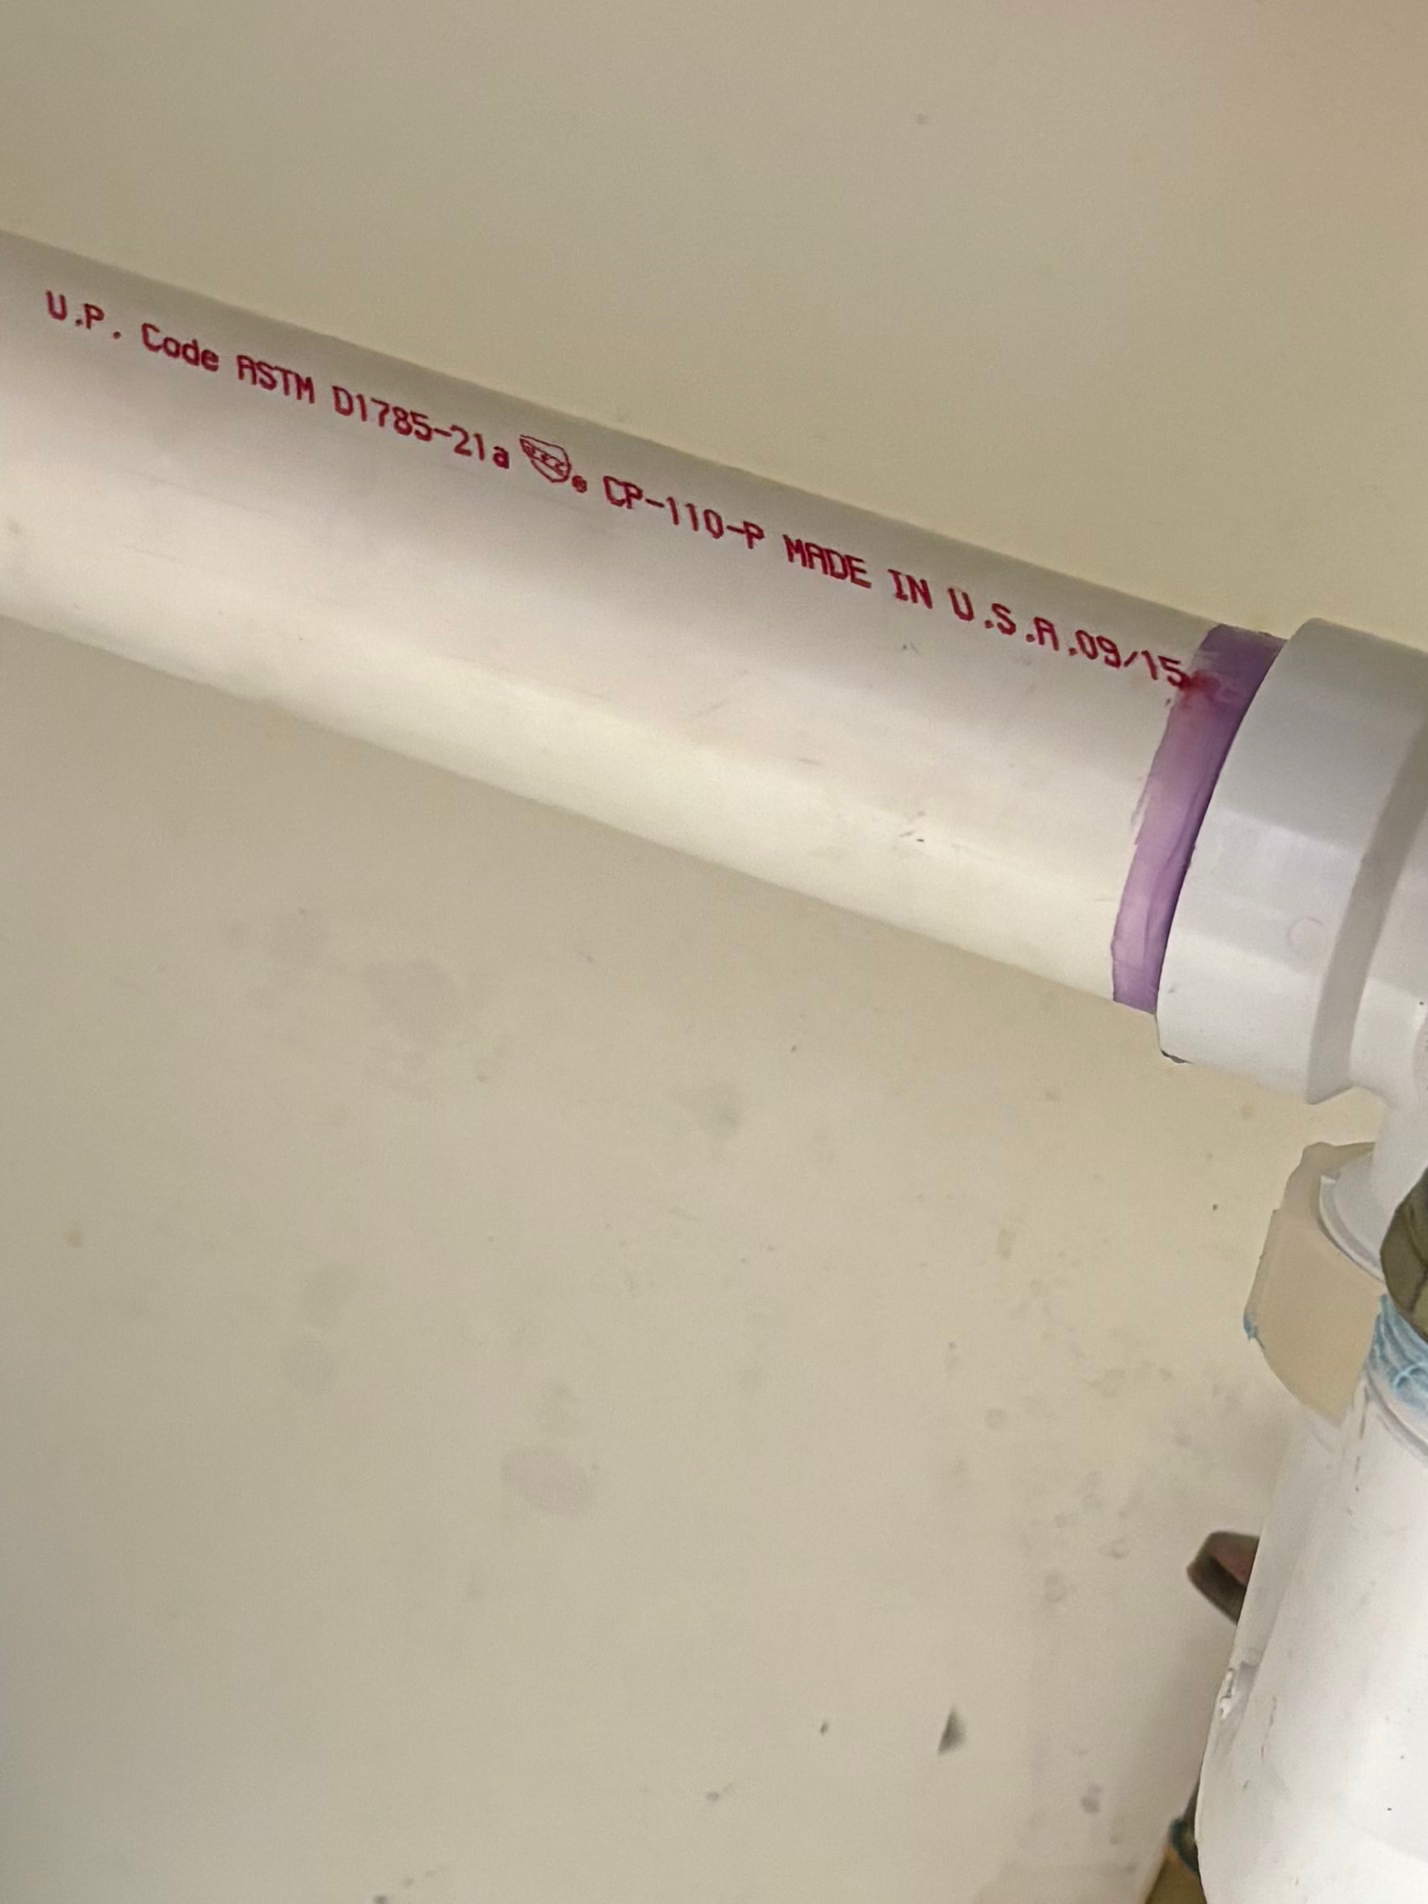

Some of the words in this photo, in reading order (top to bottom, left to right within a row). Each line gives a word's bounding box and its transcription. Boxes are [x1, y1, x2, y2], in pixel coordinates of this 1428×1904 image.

[141, 323, 219, 372] Code
[235, 355, 316, 404] ASTM
[330, 384, 510, 470] D1785-21a
[601, 474, 766, 550] CP-110-P
[783, 536, 872, 590] MADE
[889, 568, 933, 610] IN
